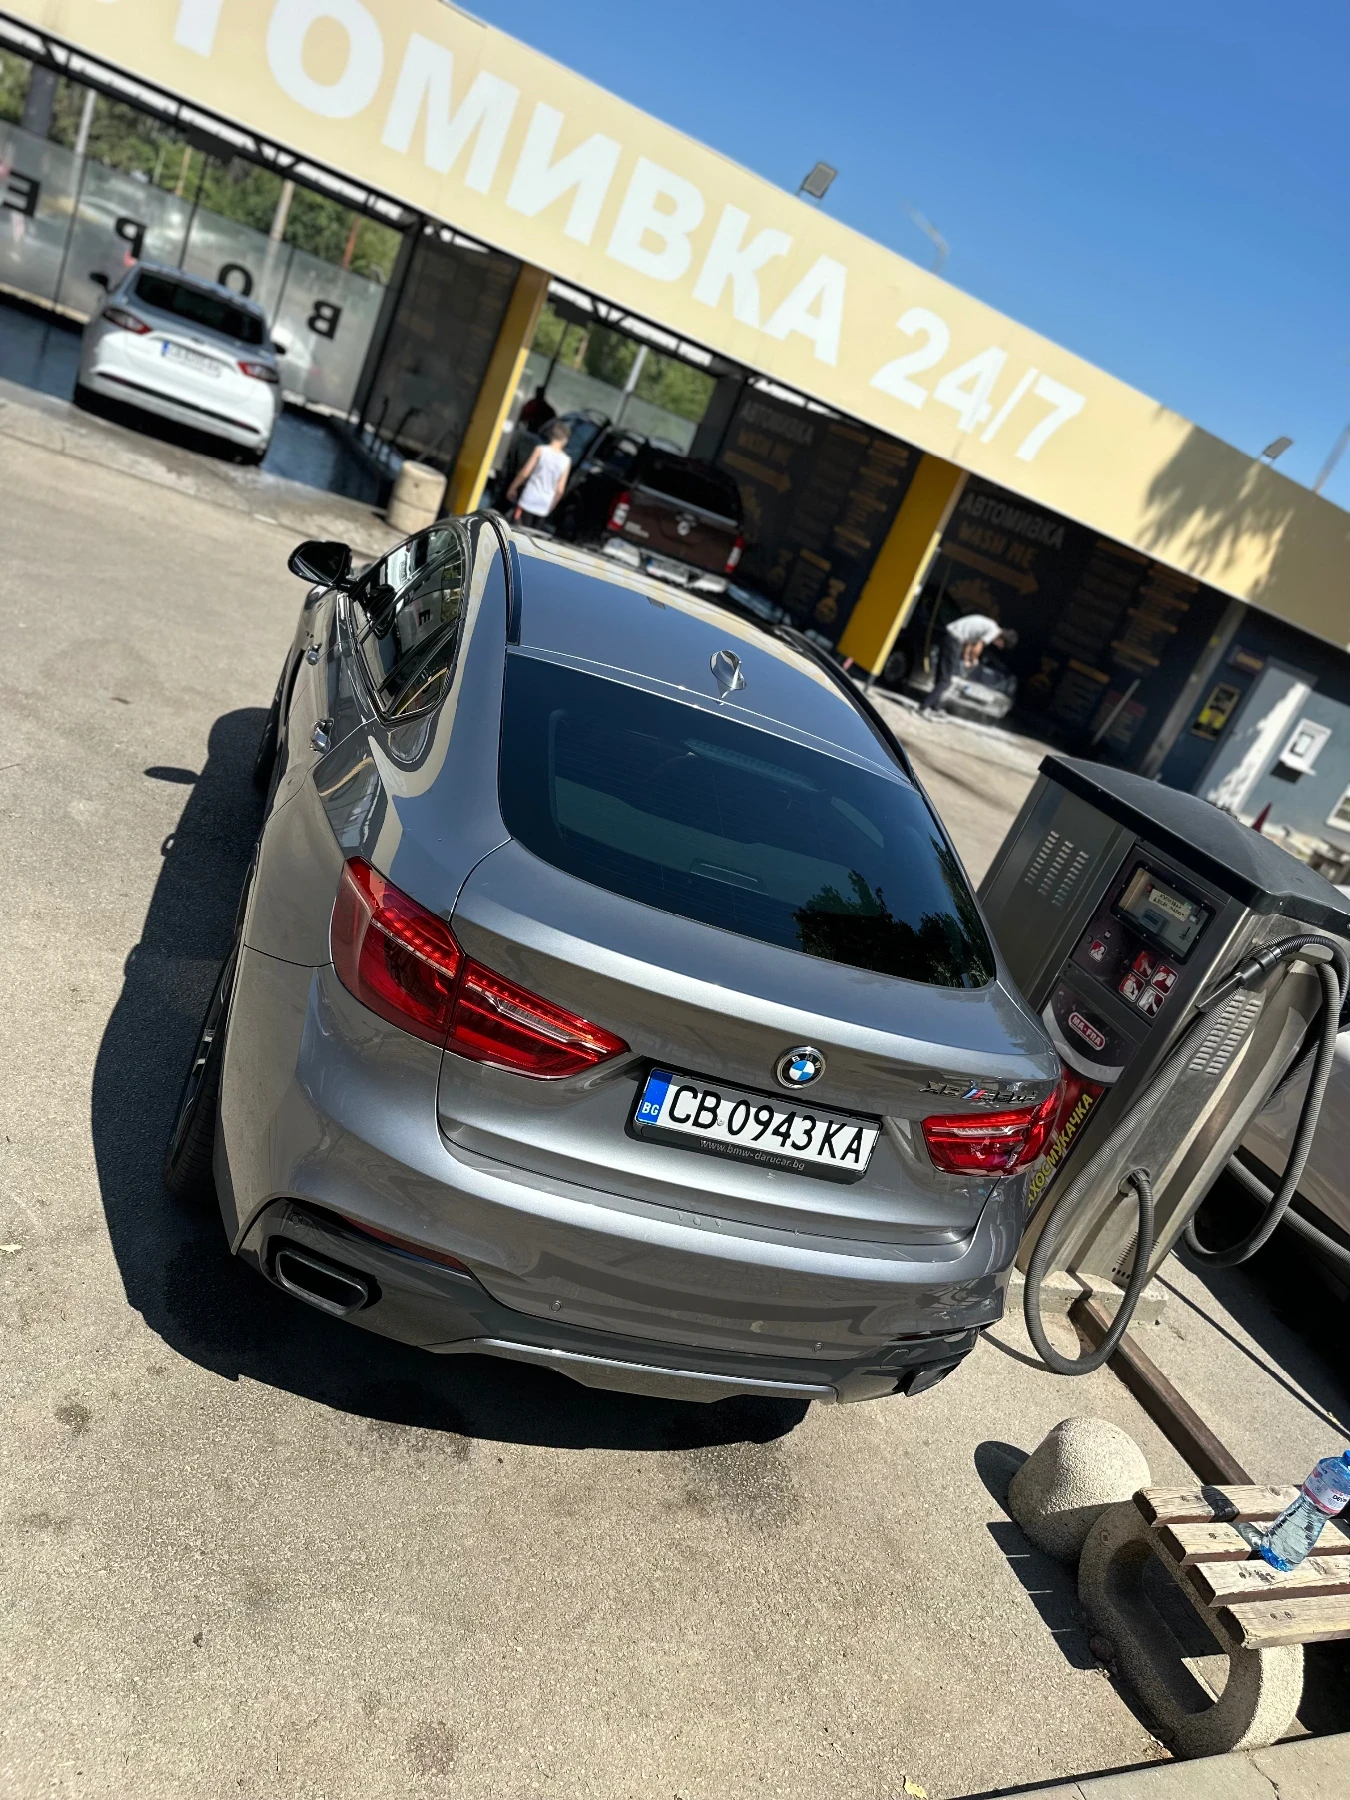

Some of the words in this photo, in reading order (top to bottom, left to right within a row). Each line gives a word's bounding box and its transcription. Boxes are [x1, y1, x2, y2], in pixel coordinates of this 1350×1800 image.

[869, 306, 1086, 462] 24/7
[959, 491, 1066, 550] АВТОМИВКА
[791, 1054, 821, 1069] BMW
[642, 1101, 659, 1117] BG
[700, 1138, 805, 1171] www.bmw-darucar.bg
